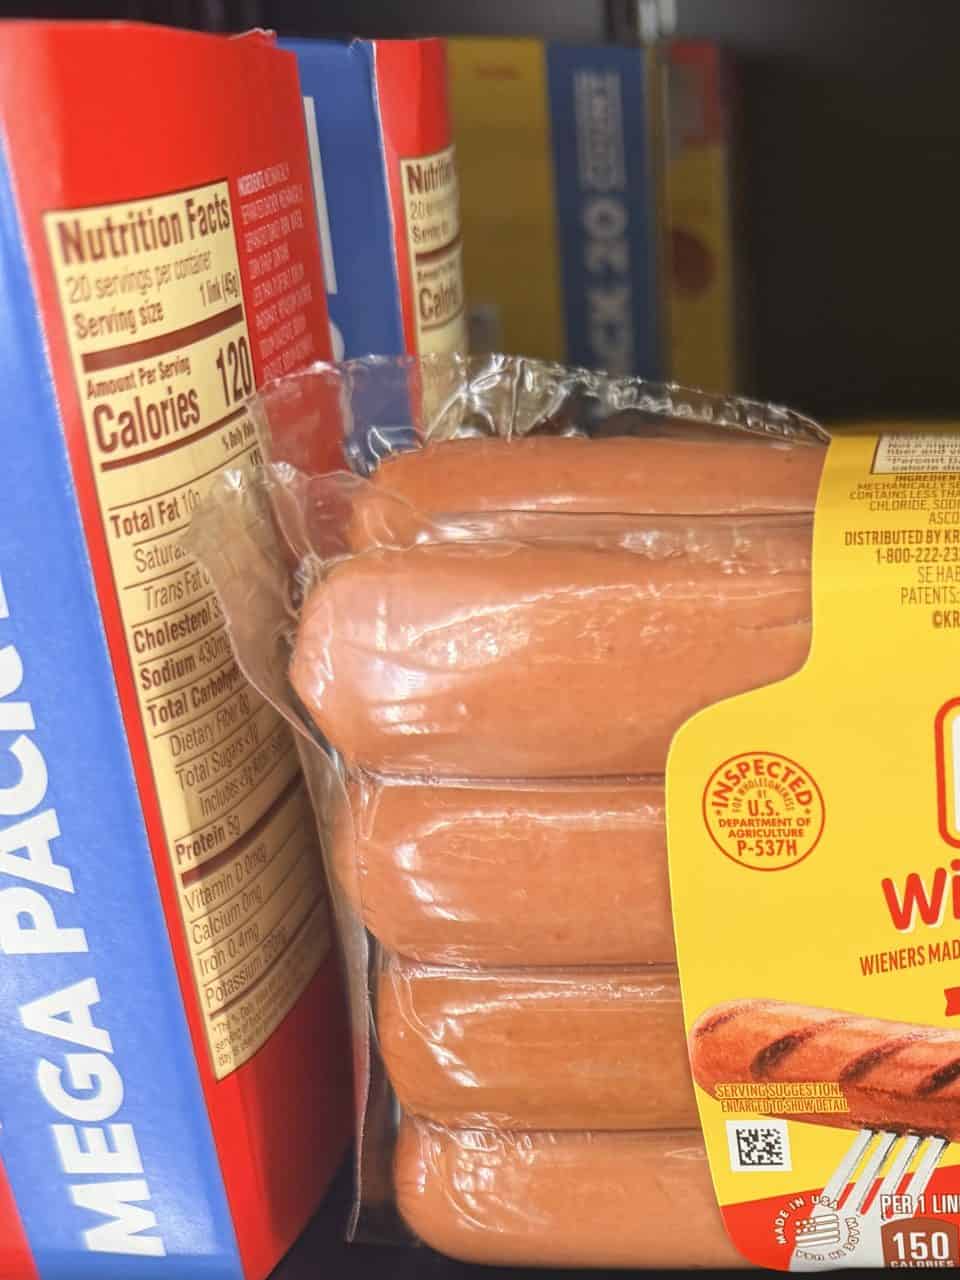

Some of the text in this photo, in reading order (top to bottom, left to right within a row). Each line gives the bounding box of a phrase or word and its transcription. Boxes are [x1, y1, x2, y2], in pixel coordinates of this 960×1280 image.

[56, 193, 231, 266] Nutrition Facts
[65, 249, 212, 304] 20 servings per container
[72, 299, 165, 339] Serving size
[86, 355, 192, 400] Amount Per Serving
[216, 336, 251, 407] 120
[92, 386, 201, 454] Calories
[109, 508, 155, 540] Total
[158, 497, 181, 529] Fat
[844, 529, 924, 546] DISTRIBUTED
[925, 529, 940, 545] BY
[144, 568, 203, 612] Trans Fat
[901, 585, 960, 606] PATENTS:
[917, 565, 935, 583] SE
[133, 602, 212, 654] Cholesterol
[711, 758, 813, 808] INSPECTED
[718, 817, 811, 828] DEPARTMENT OF
[747, 799, 780, 816] U.S.
[175, 815, 241, 865] Protein 5g
[728, 828, 804, 839] AGRICULTURE
[737, 839, 798, 857] P-537H
[191, 899, 242, 946] Calcium
[199, 948, 228, 977] Iron
[227, 923, 261, 959] 0.4mg
[859, 944, 927, 976] WIENERS
[205, 955, 263, 1009] Potassium
[19, 977, 168, 1258] MEGA
[721, 1099, 771, 1113] ENLARGED
[771, 1099, 784, 1112] TO
[784, 1098, 815, 1112] SHOW
[774, 1195, 839, 1244] MADE IN USA
[881, 1195, 914, 1214] PER
[917, 1195, 925, 1214] 1
[892, 1231, 949, 1261] 150
